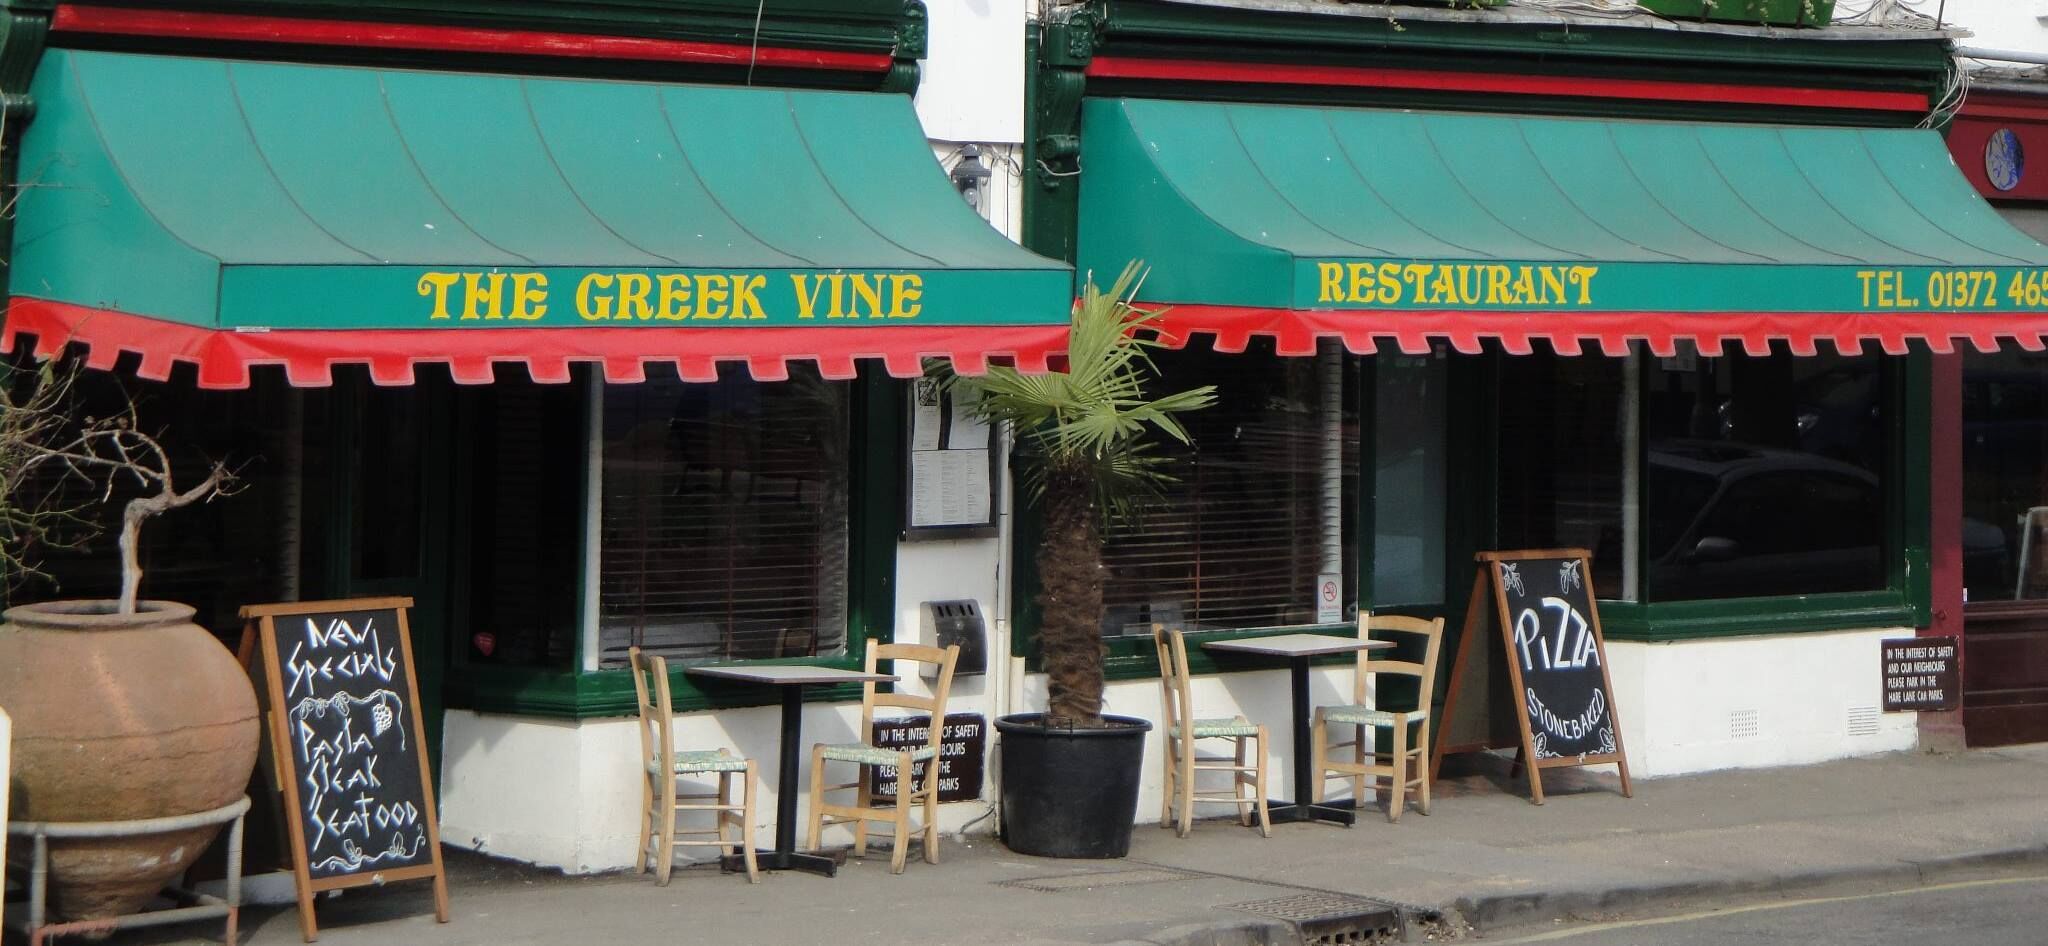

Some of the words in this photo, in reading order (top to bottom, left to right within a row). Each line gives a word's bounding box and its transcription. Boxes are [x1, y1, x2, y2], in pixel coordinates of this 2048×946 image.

[1318, 262, 1598, 304] RESTAURANT
[1857, 271, 1919, 307] TEL.
[1928, 271, 1997, 307] 01372
[417, 271, 548, 320] THE
[576, 273, 766, 321] GREEK
[790, 273, 923, 320] VINE
[1887, 649, 1894, 660] IN
[1895, 649, 1905, 659] THE
[1906, 648, 1927, 659] INTEREST
[1928, 647, 1936, 658] OF
[1937, 646, 1953, 657] SAFETY
[1888, 663, 1899, 673] AND
[1900, 662, 1913, 673] OUR
[1913, 661, 1946, 673] NEIGHBOURS
[1887, 677, 1905, 689] PLEASE
[1906, 676, 1918, 688] PARK
[1919, 676, 1926, 687] IN
[1927, 675, 1936, 687] THE
[1888, 691, 1901, 703] HARE
[1902, 690, 1916, 702] LANE
[1917, 690, 1928, 701] CAR
[1928, 689, 1944, 701] PARKS
[1527, 687, 1605, 740] STONEBAKED
[880, 729, 889, 743] IN
[892, 728, 906, 742] THE
[942, 726, 952, 738] OF
[954, 724, 980, 738] SAFETY
[938, 777, 960, 792] PARKS
